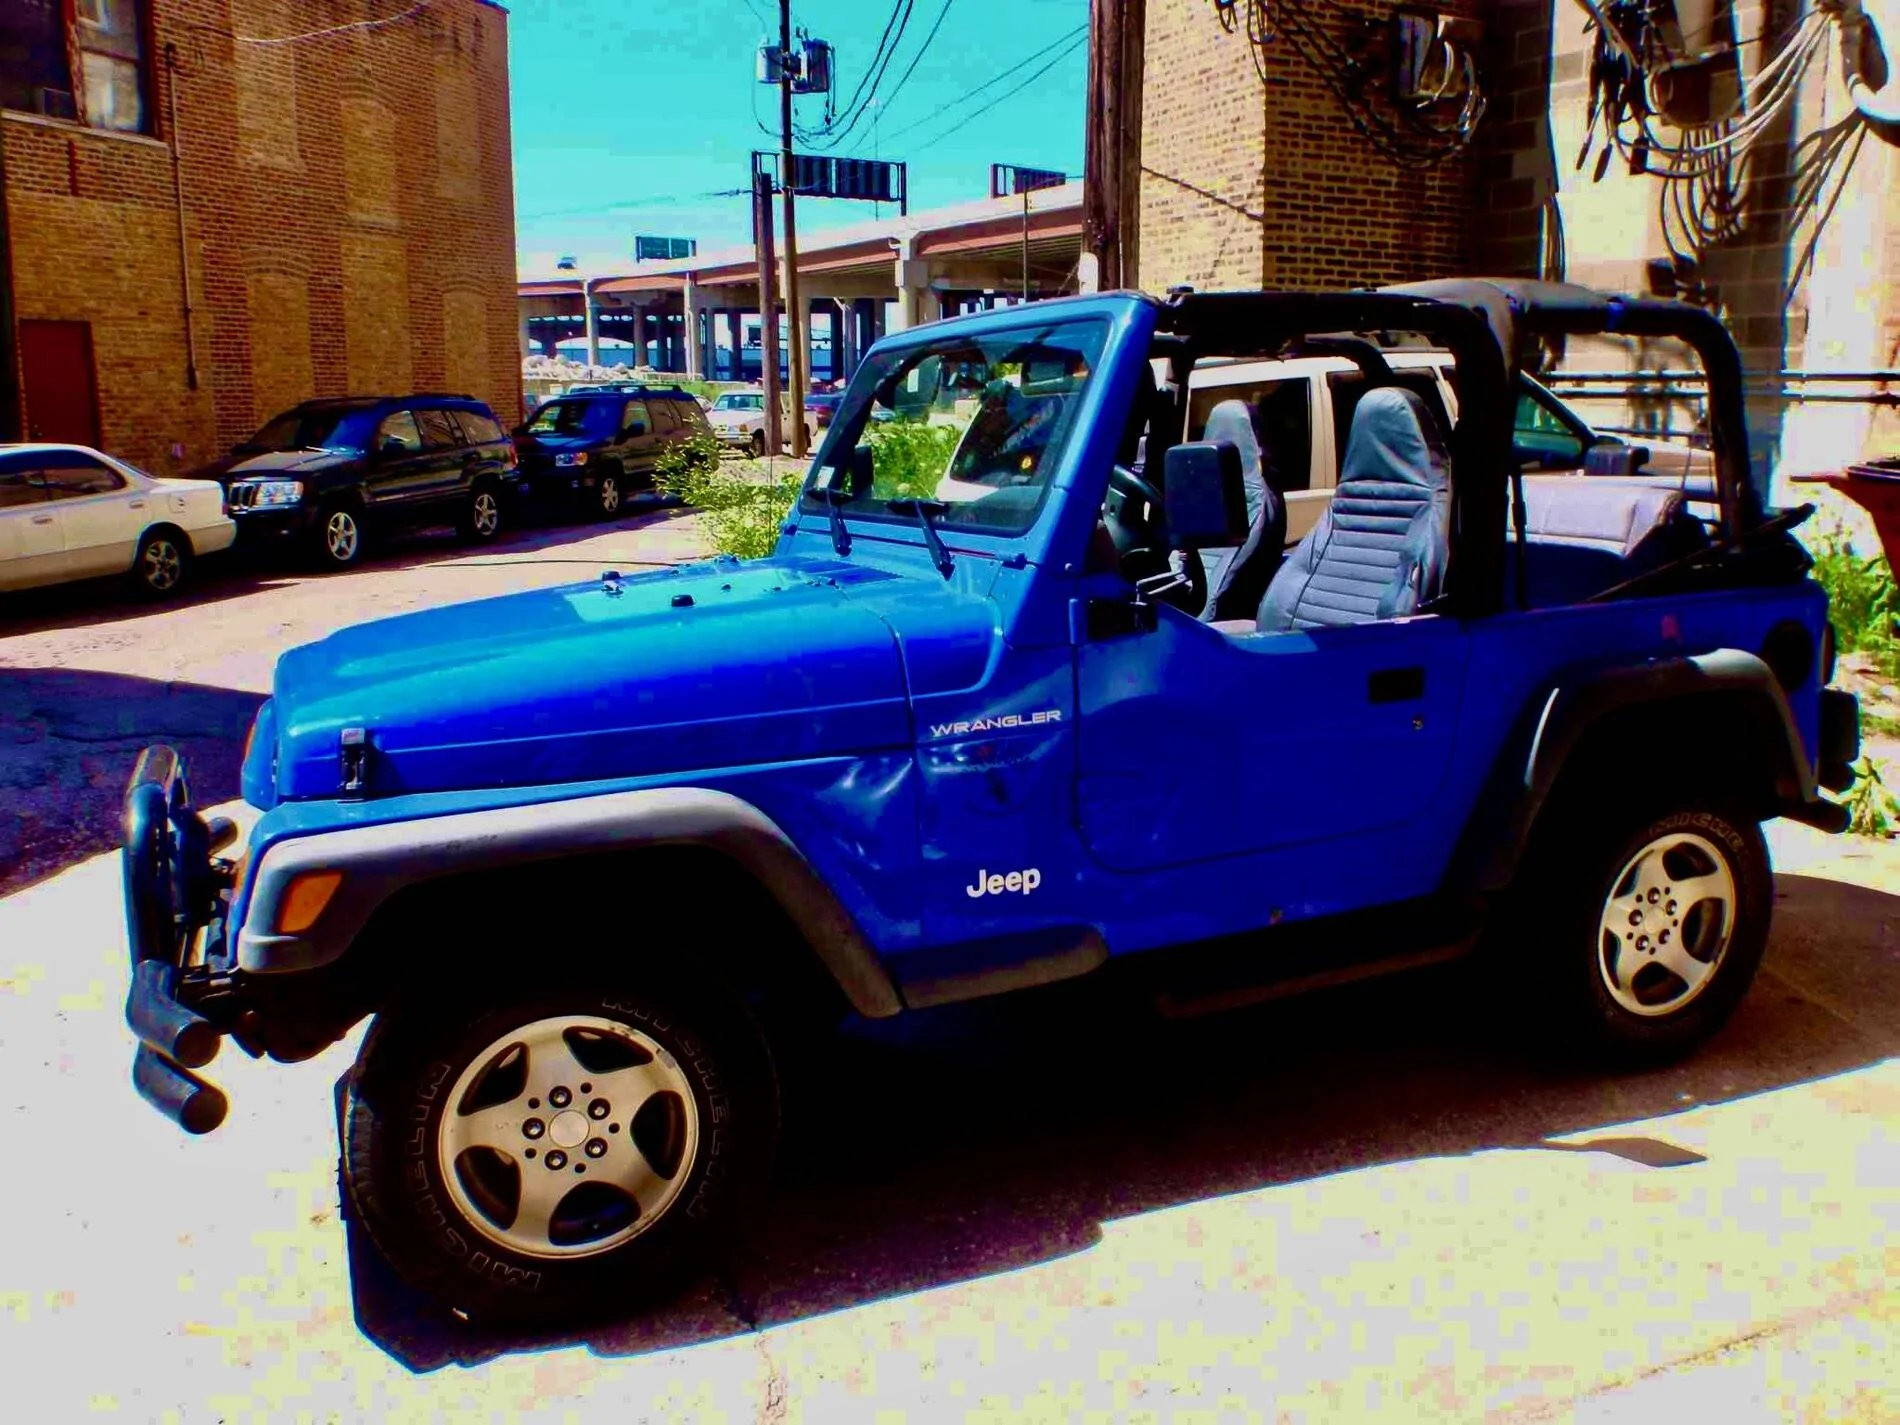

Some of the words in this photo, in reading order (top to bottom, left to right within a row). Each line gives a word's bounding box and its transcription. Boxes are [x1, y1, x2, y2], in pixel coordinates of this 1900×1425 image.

[930, 709, 1062, 737] WRANGLER
[966, 867, 1041, 898] Jeep
[405, 1062, 542, 1292] MICHELIN
